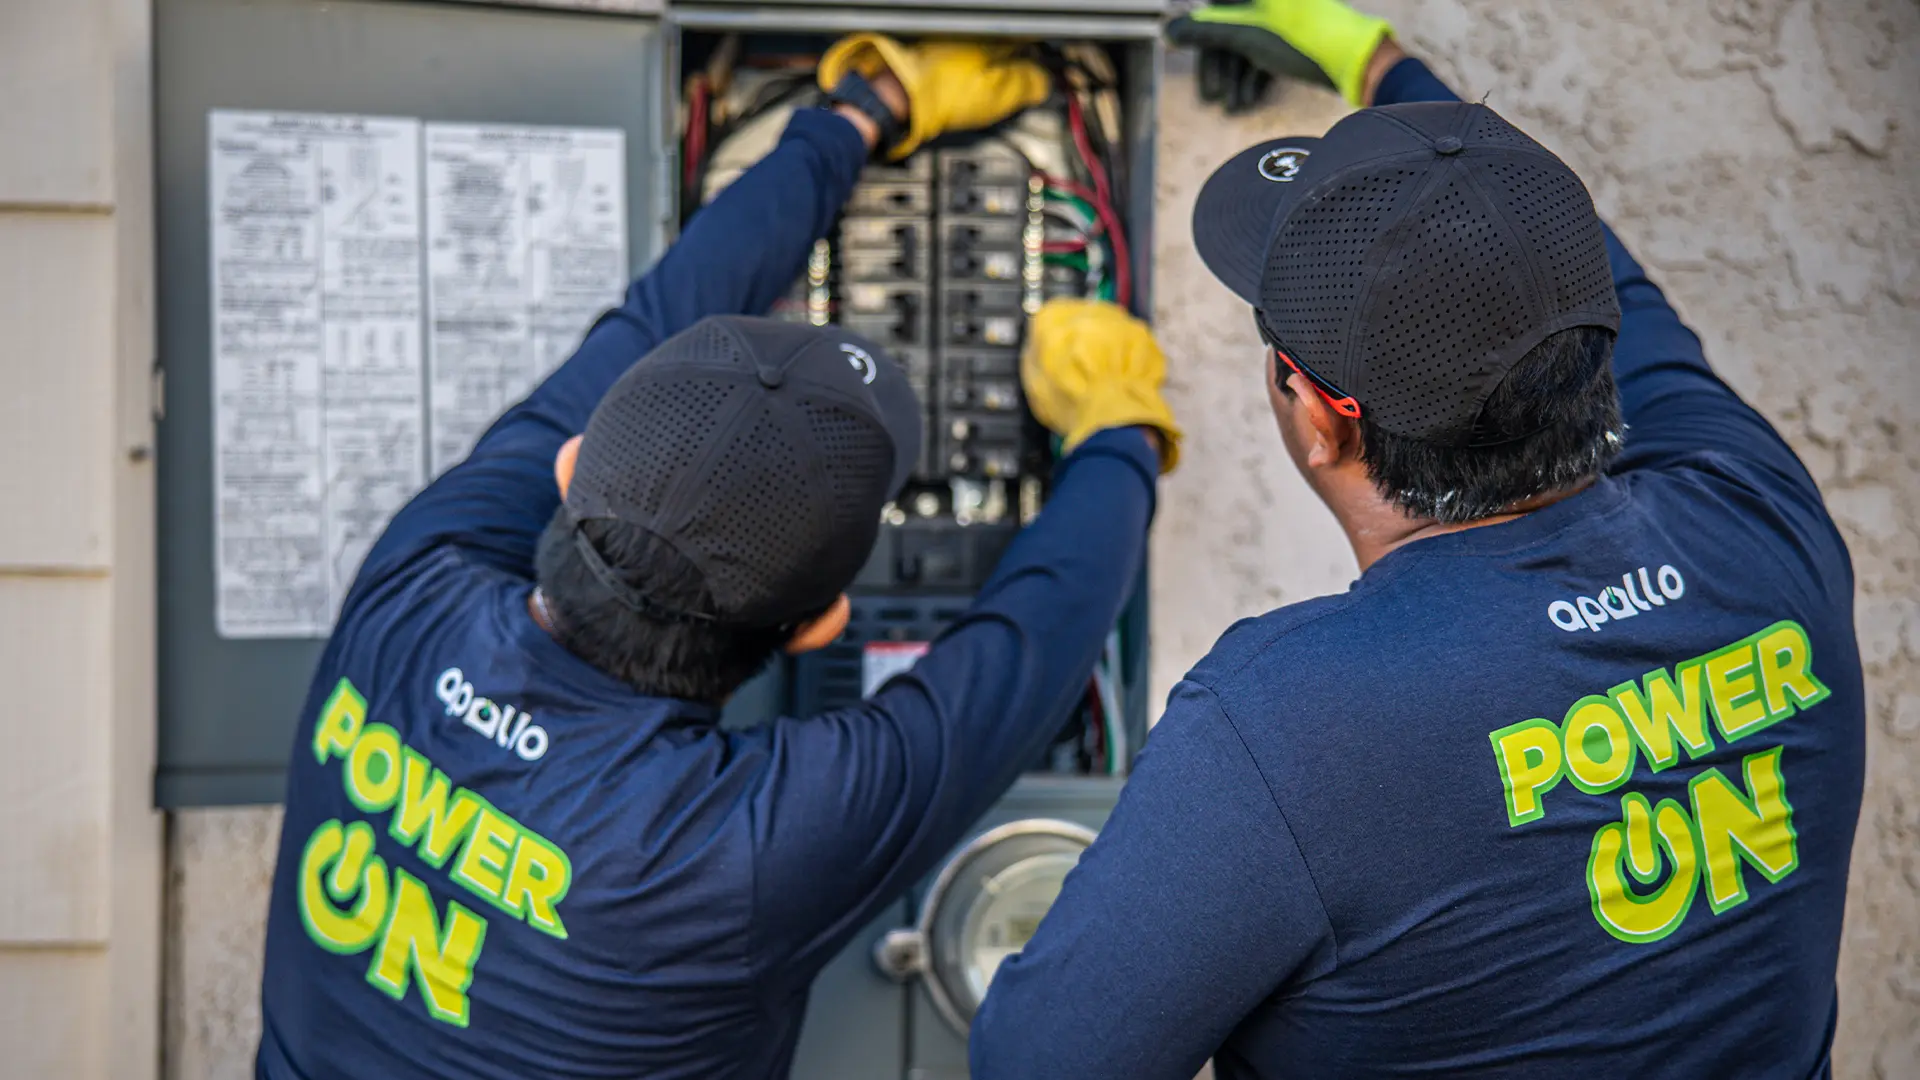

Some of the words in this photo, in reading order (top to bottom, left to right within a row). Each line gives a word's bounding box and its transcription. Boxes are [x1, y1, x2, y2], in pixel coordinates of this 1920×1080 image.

[1547, 564, 1686, 632] apollo
[312, 676, 572, 940] POWER
[1489, 619, 1832, 828] POWER
